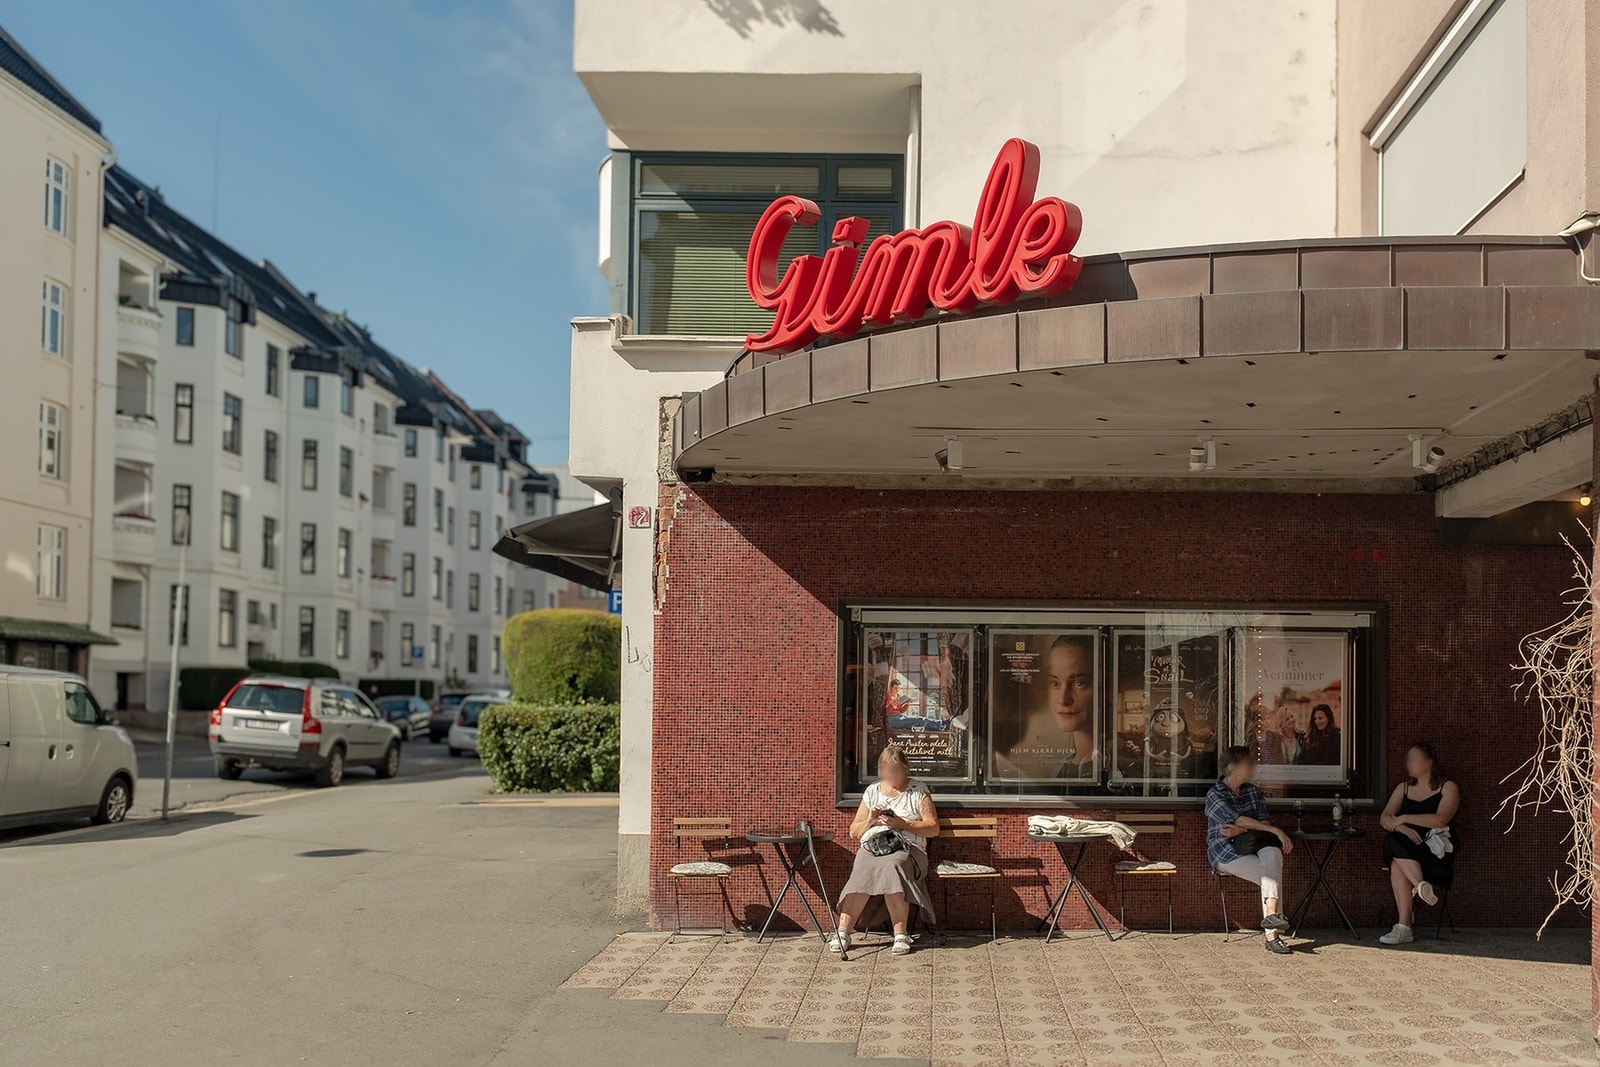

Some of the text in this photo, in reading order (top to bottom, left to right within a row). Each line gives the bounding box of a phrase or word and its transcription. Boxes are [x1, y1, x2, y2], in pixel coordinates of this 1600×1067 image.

[744, 138, 1084, 355] Gimle
[1283, 657, 1303, 669] Tre
[1262, 668, 1325, 680] Venninner
[905, 738, 929, 747] Austen
